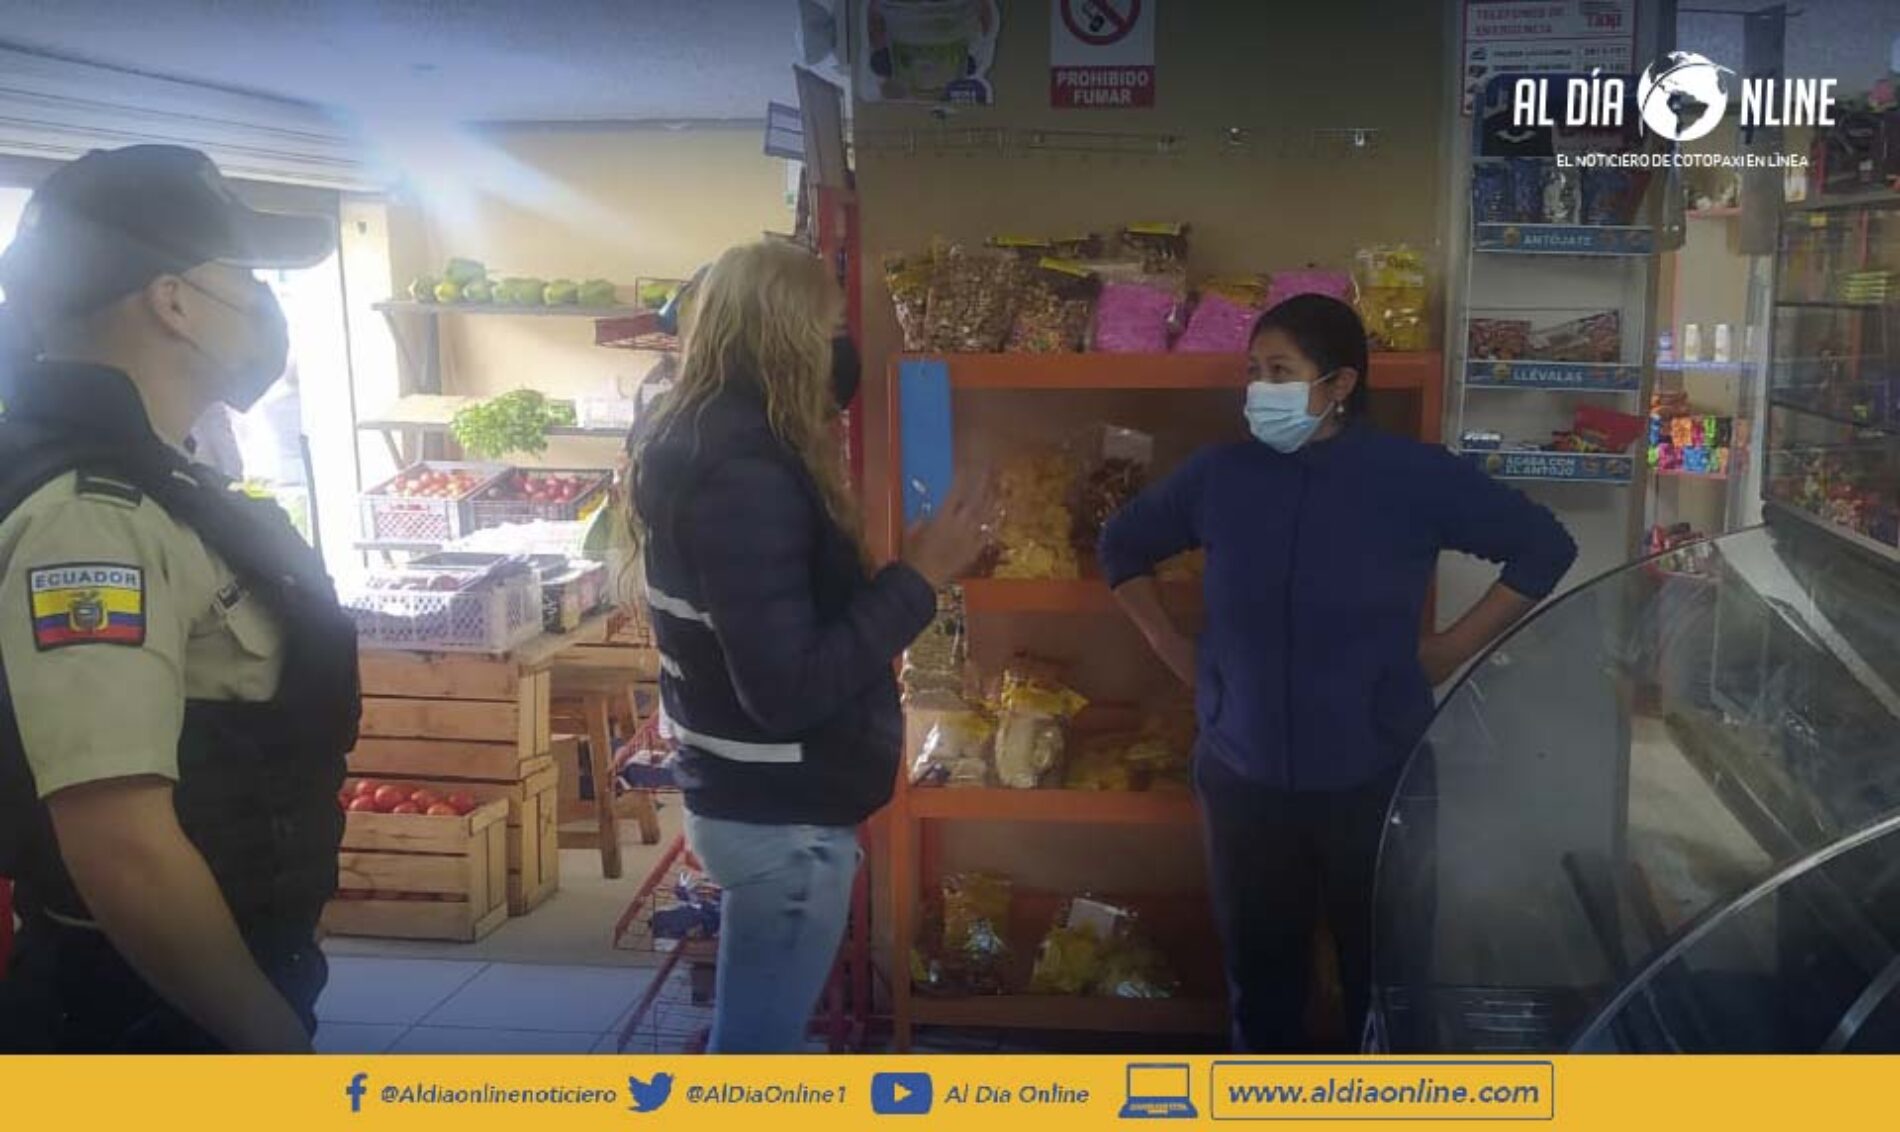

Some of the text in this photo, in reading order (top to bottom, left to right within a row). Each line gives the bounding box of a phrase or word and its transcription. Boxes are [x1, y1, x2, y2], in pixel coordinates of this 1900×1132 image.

[1056, 71, 1149, 87] PROHIBIDO
[1073, 89, 1132, 105] FUMAR
[1522, 466, 1575, 476] ANTOJO
[34, 570, 138, 589] ECUADOR
